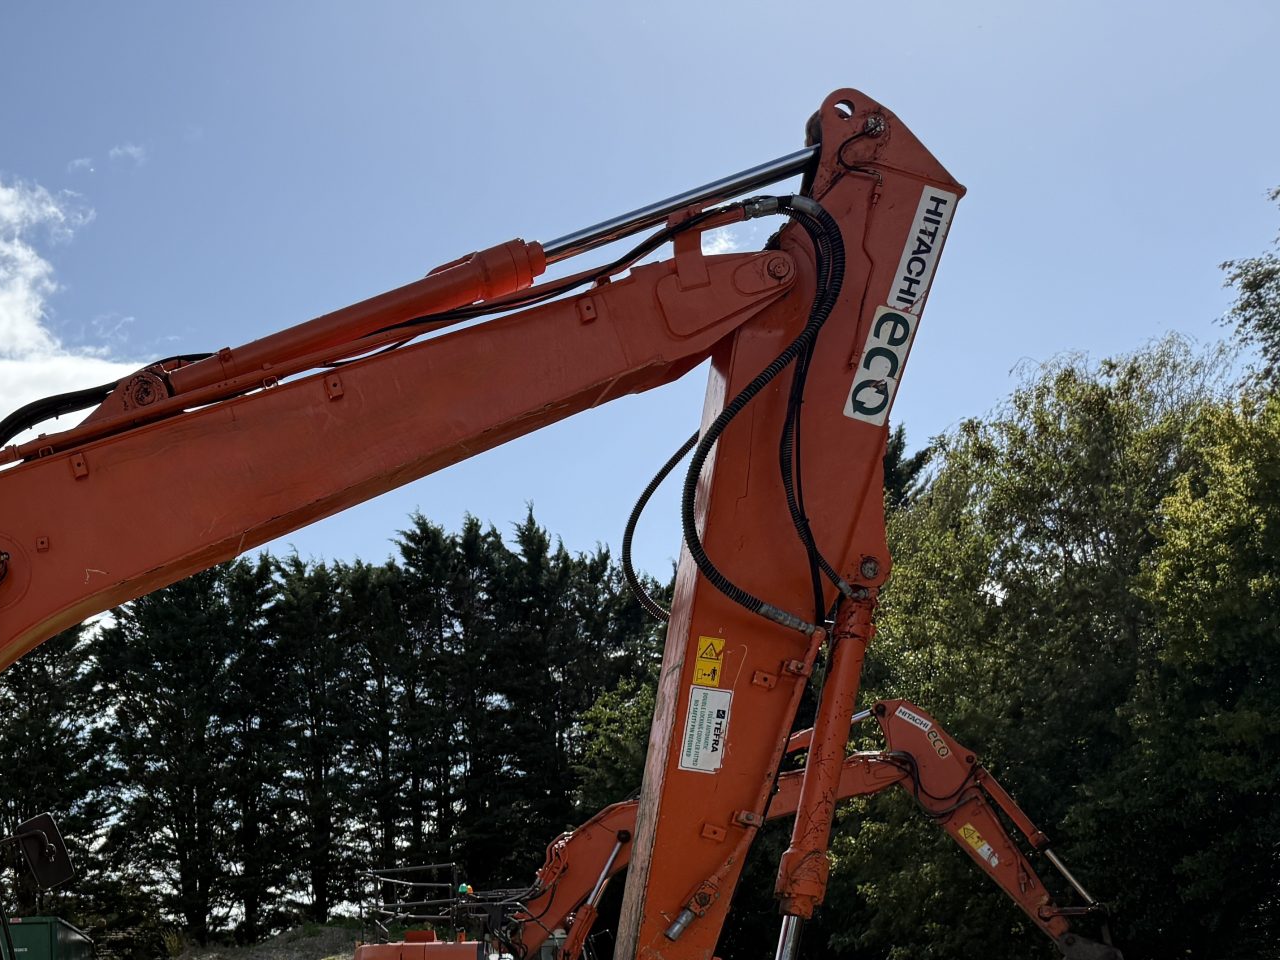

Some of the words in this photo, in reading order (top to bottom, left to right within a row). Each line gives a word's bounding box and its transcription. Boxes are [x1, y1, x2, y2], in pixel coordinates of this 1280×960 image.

[896, 195, 947, 305] HITACHI
[898, 709, 929, 729] HITACHI
[686, 734, 694, 757] REQUIRED
[703, 725, 711, 750] AUTOMATIC
[711, 720, 722, 753] TEFRA
[927, 730, 949, 757] eco
